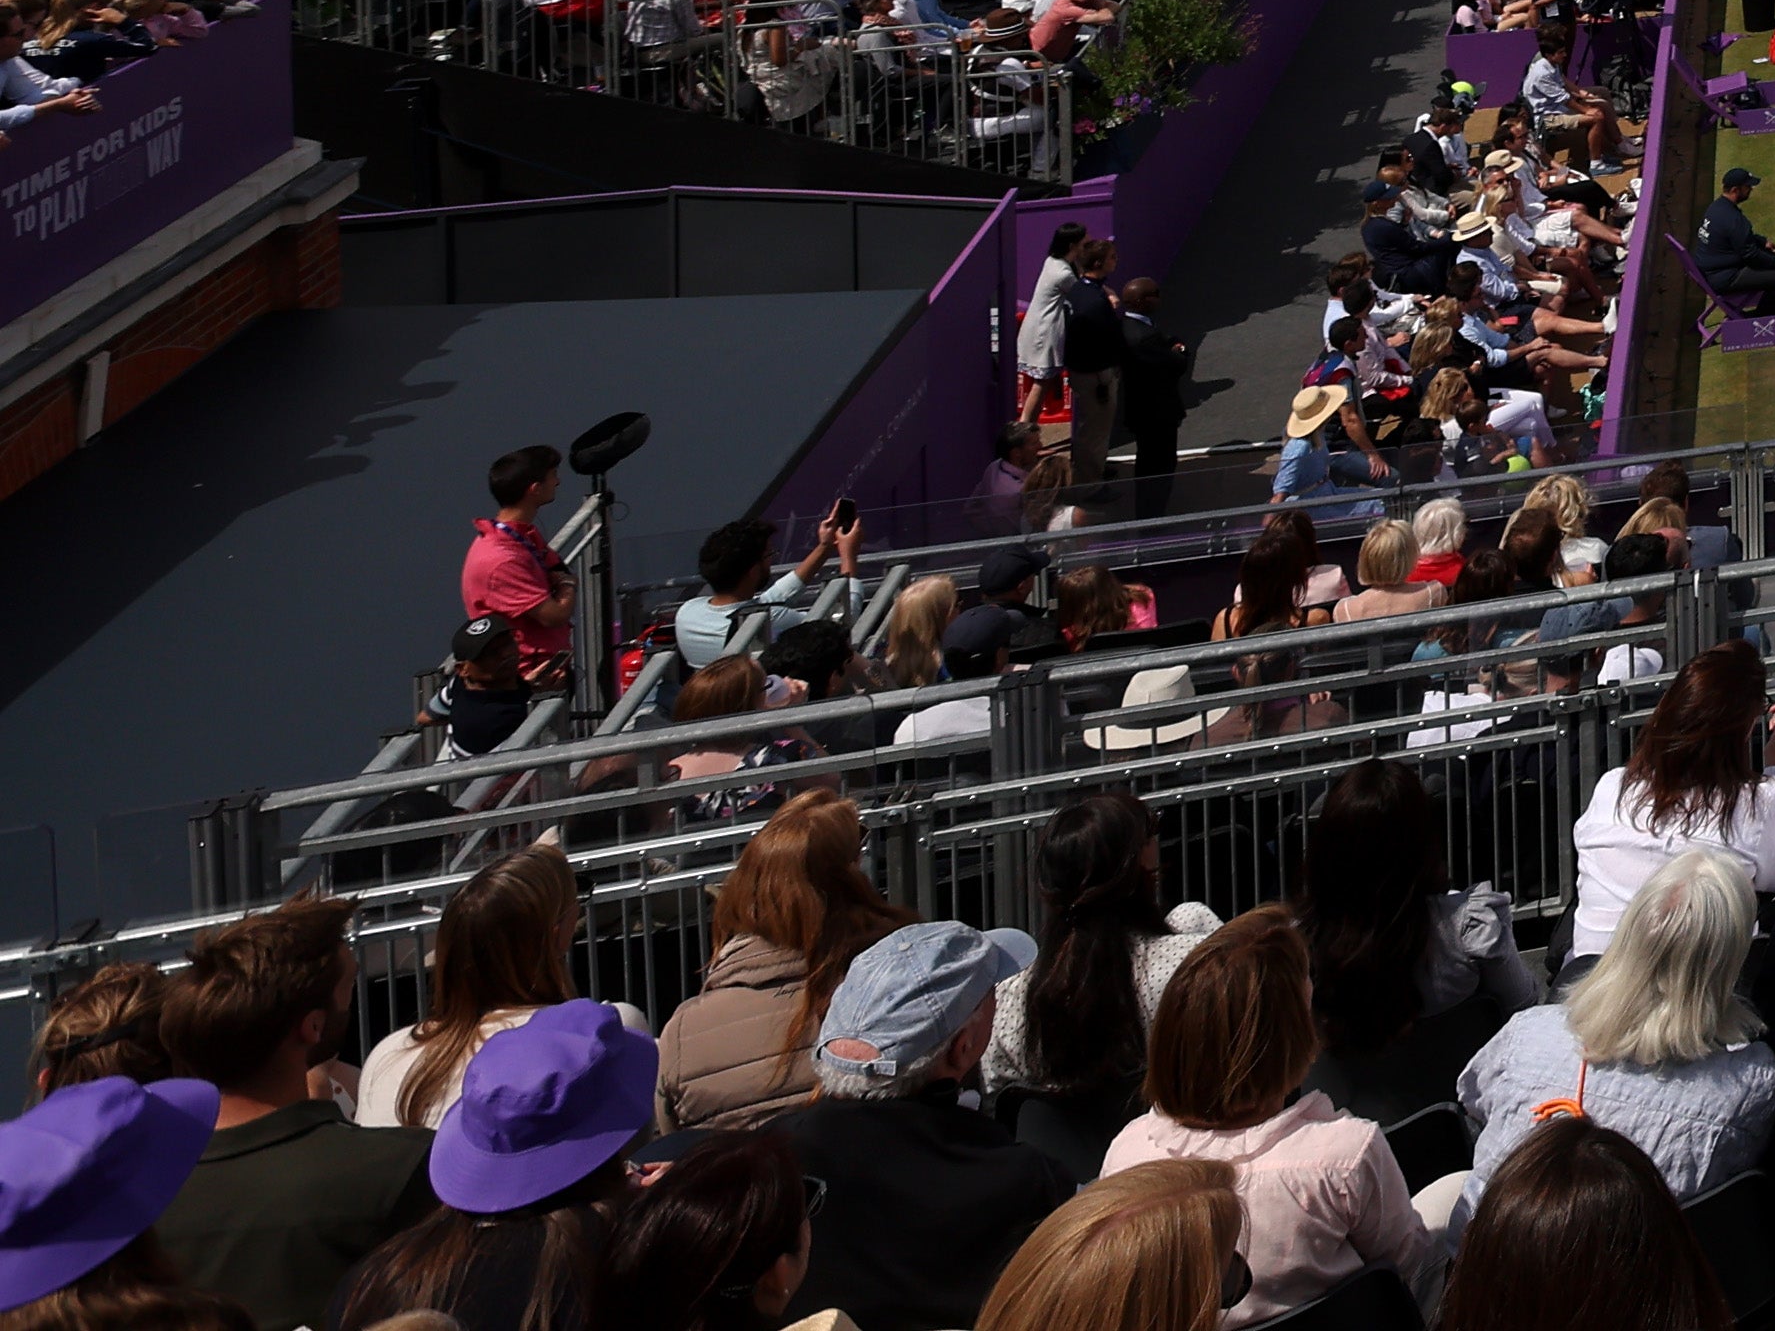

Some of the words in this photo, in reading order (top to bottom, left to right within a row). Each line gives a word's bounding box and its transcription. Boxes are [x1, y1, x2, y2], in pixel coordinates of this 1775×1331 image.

[1, 156, 72, 209] TIME
[77, 128, 125, 172] FOR
[129, 95, 184, 143] KIDS
[12, 205, 37, 237] TO
[39, 175, 90, 242] PLAY
[146, 121, 184, 179] WAY
